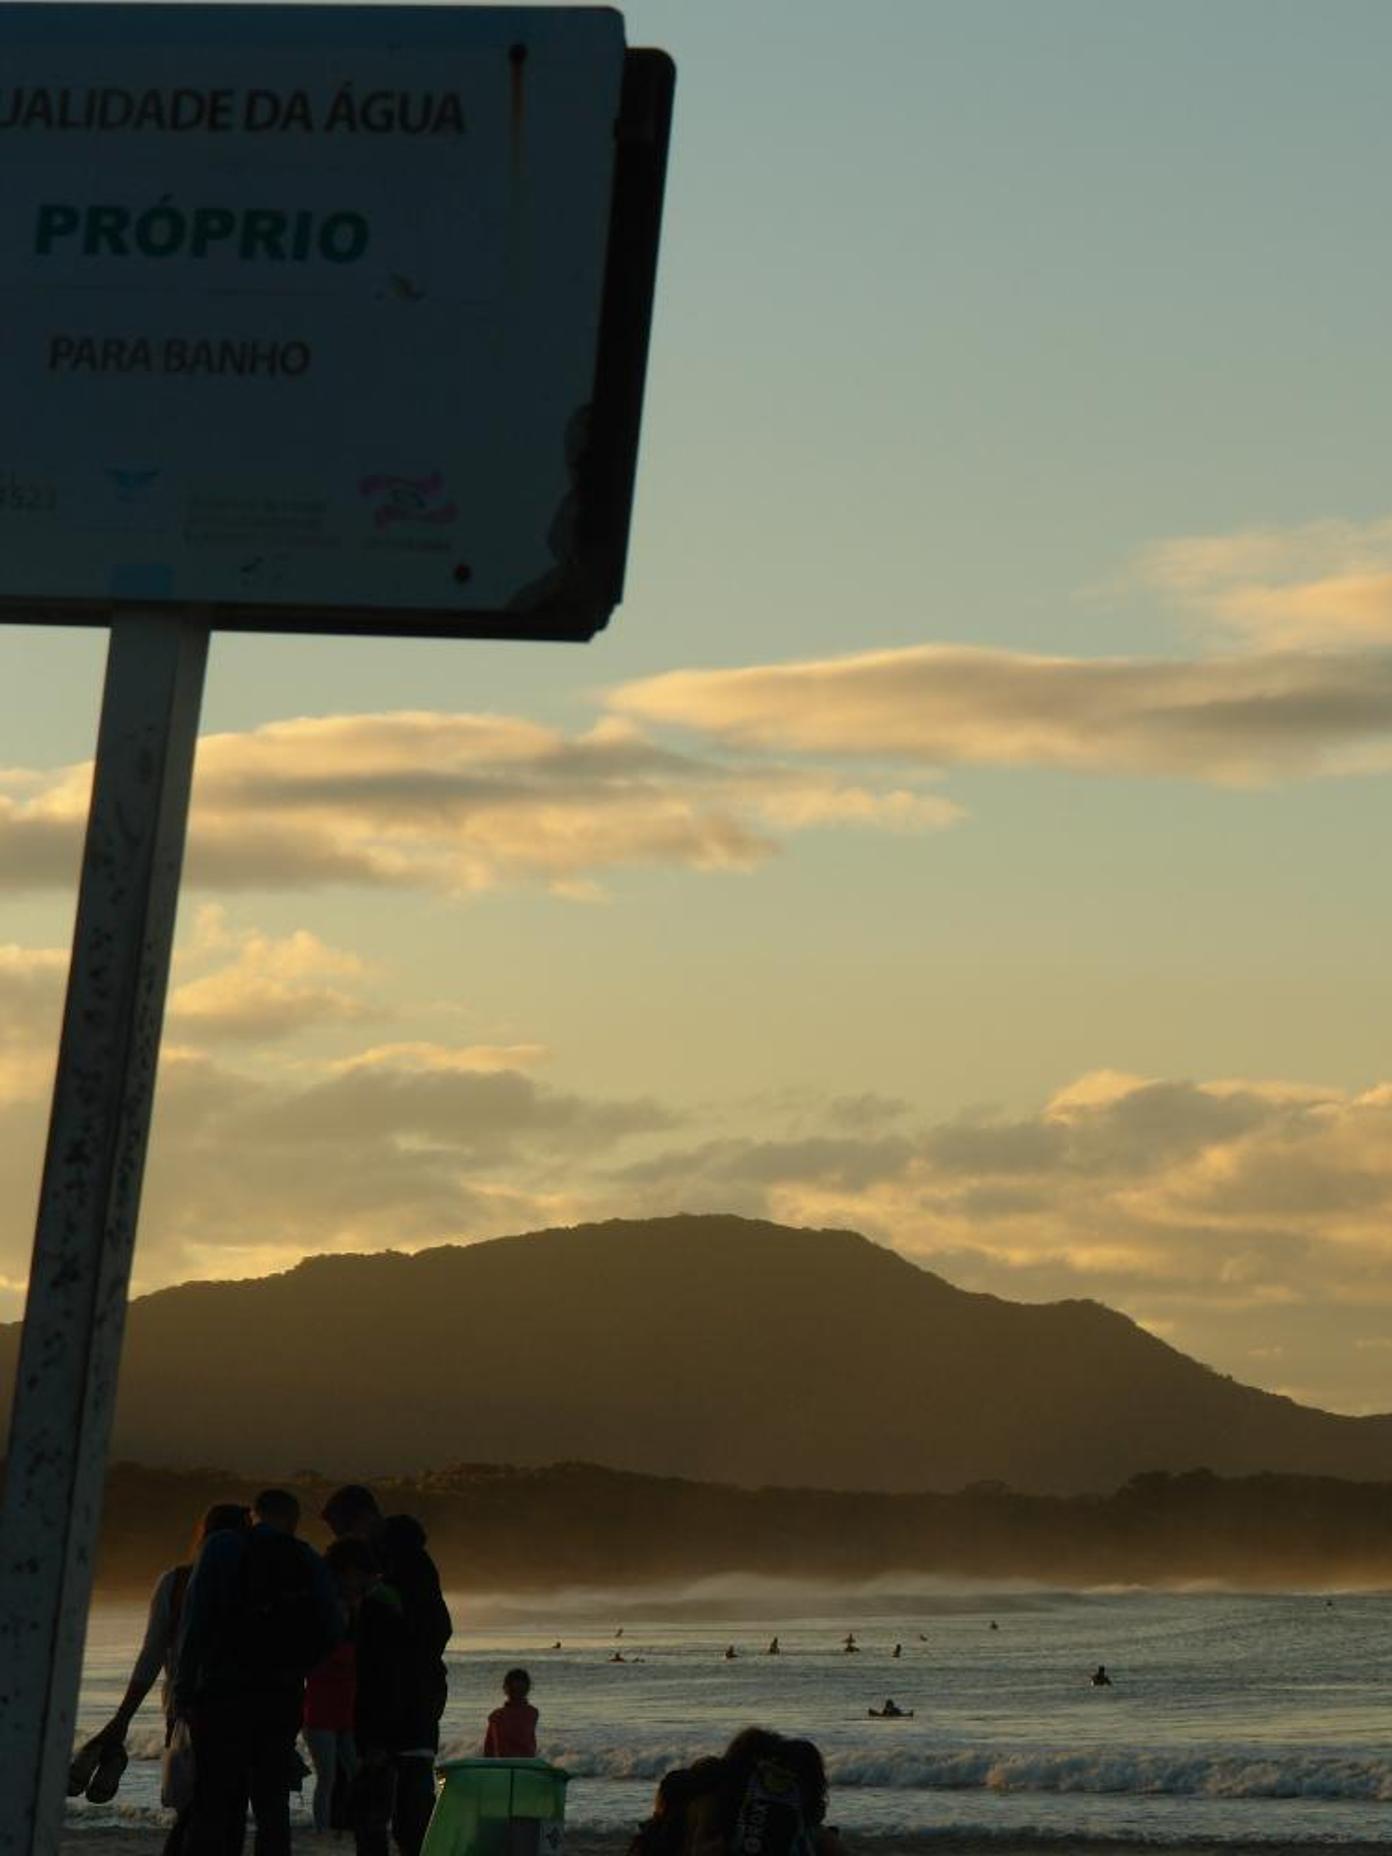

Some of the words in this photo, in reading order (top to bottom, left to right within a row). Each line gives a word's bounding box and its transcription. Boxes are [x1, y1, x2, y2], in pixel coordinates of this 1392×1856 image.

[244, 88, 313, 133] DA
[324, 82, 466, 135] ÁGUA
[34, 195, 369, 263] PRÓPRIO
[49, 336, 152, 374] PARA
[163, 338, 311, 376] BANHO
